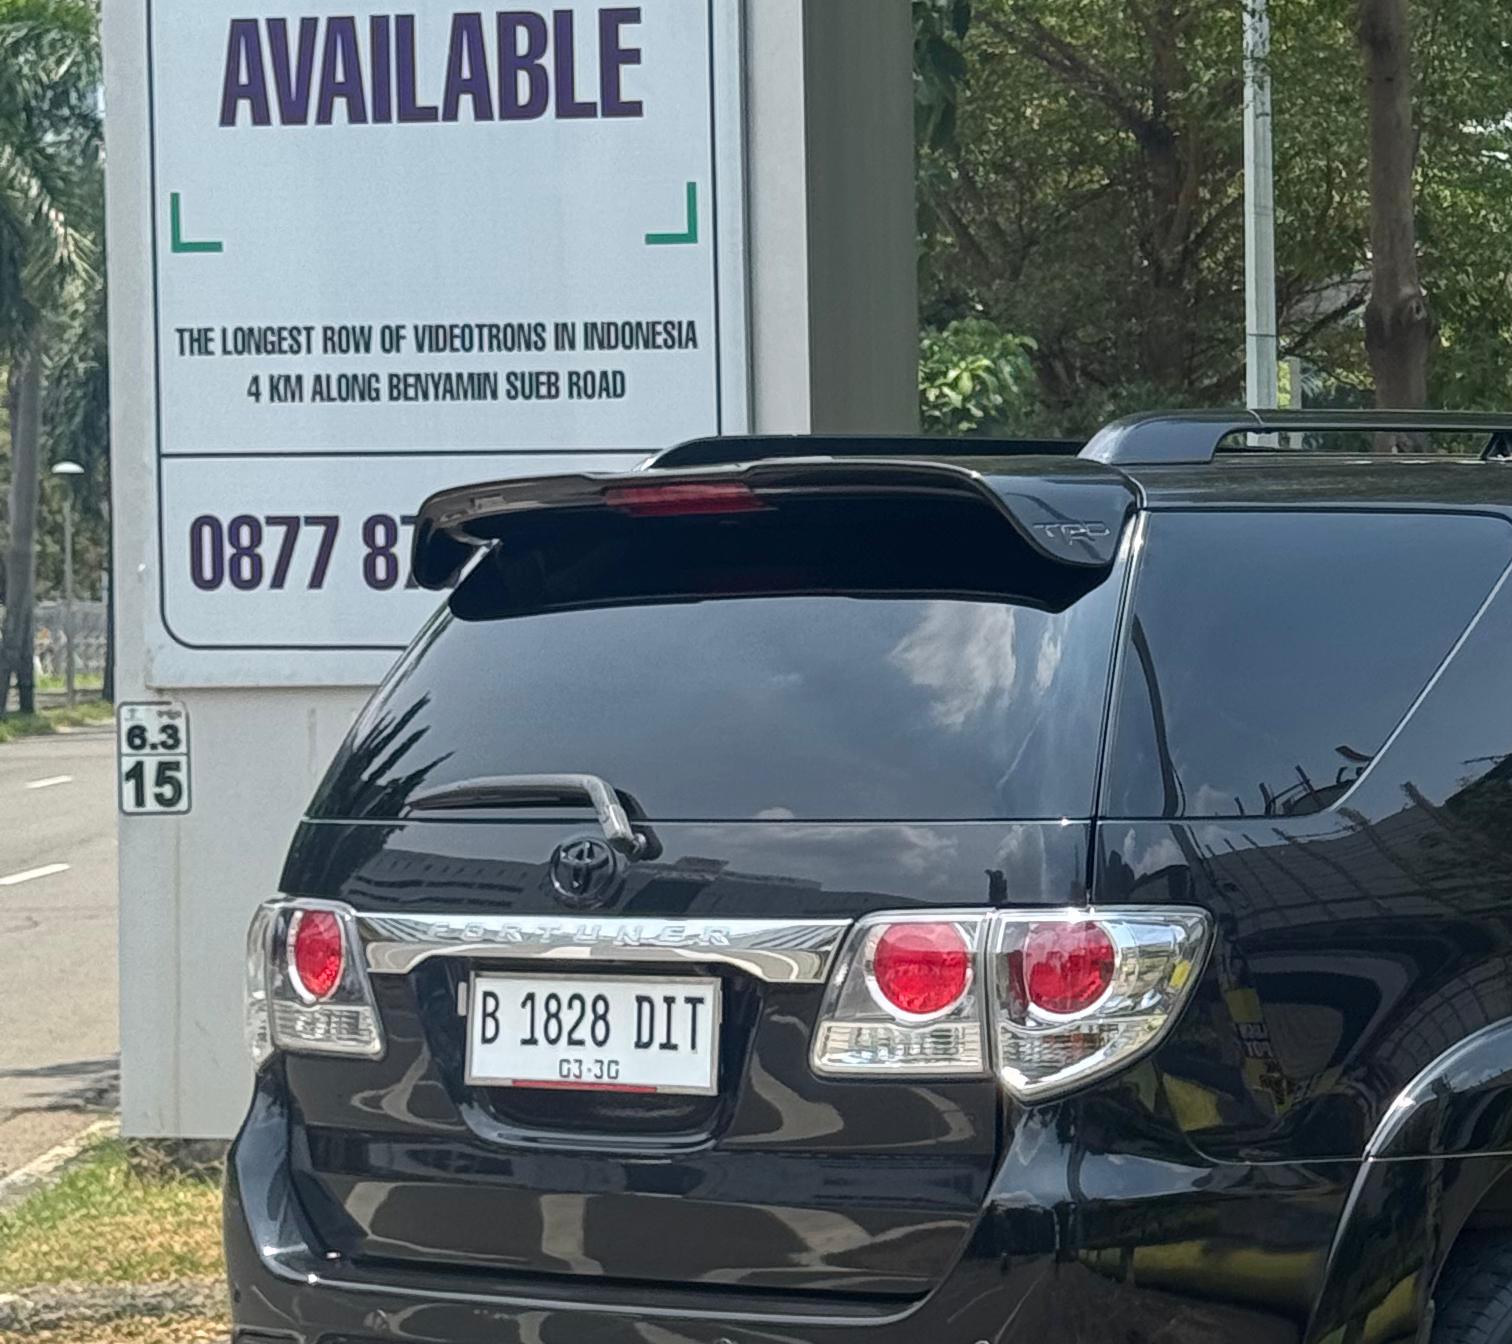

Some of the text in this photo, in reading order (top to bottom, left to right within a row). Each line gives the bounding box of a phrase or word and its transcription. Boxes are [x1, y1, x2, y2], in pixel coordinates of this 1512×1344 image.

[218, 6, 644, 127] AVAILABLE
[175, 320, 698, 356] THE LONGEST ROW OF VIDEOTRONS IN INDONESIA
[247, 370, 626, 403] 4 KM ALONG BENYAMIN SUEB ROAD
[189, 514, 340, 590] 0877
[126, 724, 182, 751] 6.3
[125, 760, 183, 808] 15
[427, 921, 732, 947] FORTUNER
[480, 991, 705, 1051] B 1828 DIT
